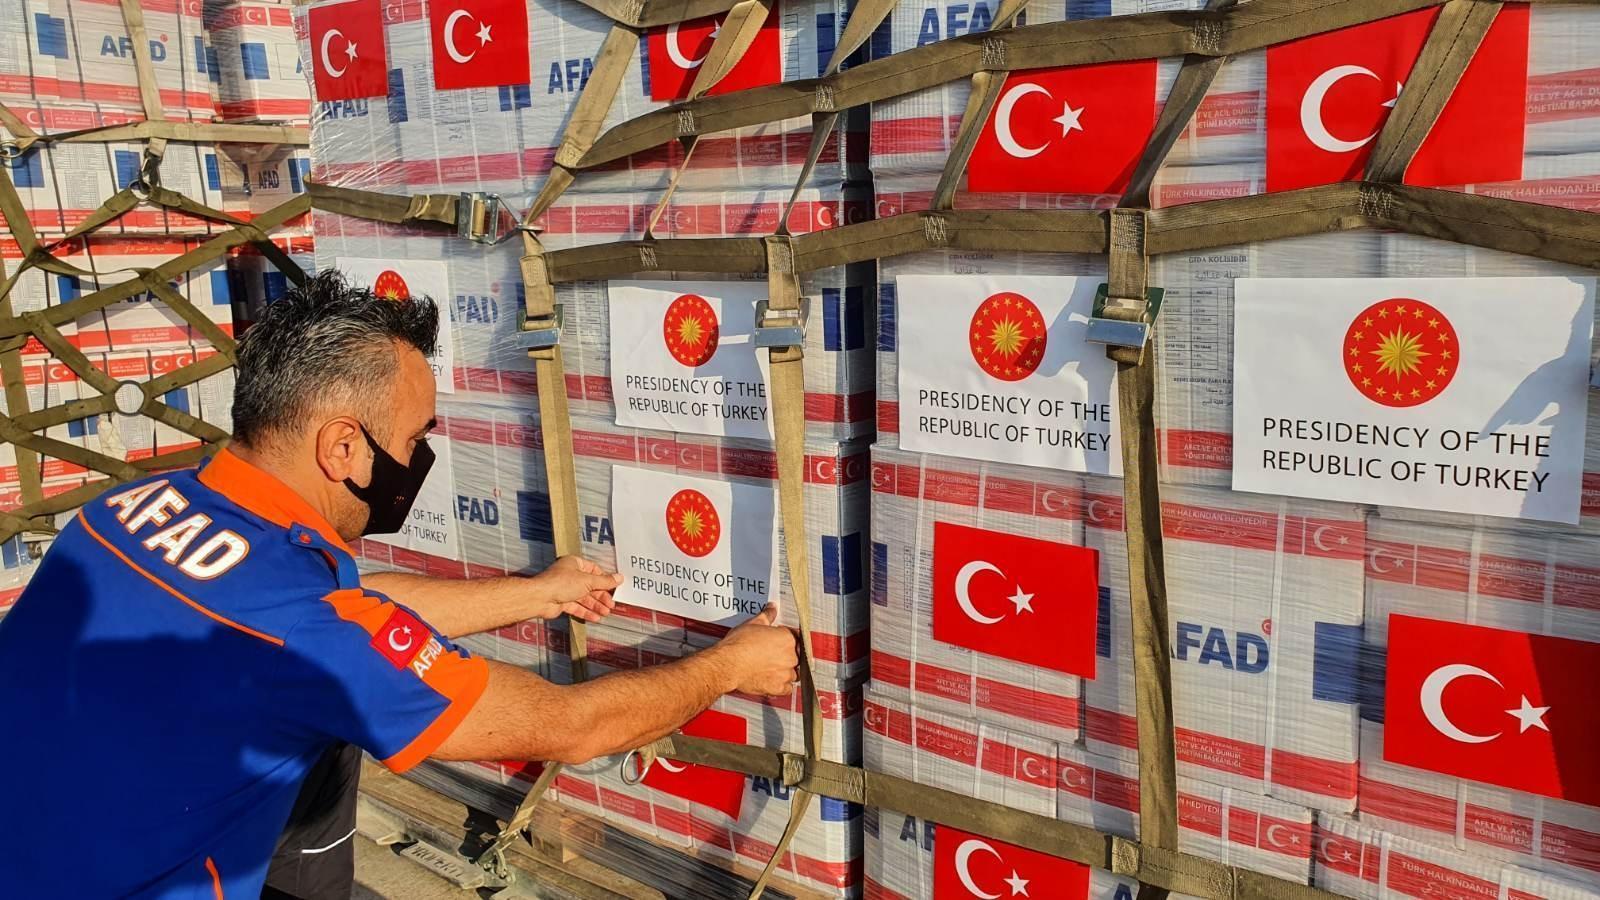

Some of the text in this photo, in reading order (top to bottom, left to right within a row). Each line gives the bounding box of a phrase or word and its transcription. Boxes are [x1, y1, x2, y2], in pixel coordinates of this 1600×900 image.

[100, 35, 167, 62] AFD
[548, 58, 594, 94] AFA
[626, 375, 709, 393] PRESIDENCY
[713, 381, 733, 396] OF
[739, 383, 766, 398] THE
[629, 397, 767, 421] REPUBLIC OF TURKEY
[919, 389, 1111, 422] PRESIDENCY OF THE
[919, 416, 1112, 451] REPUBLIC OF TURKEY
[1263, 417, 1550, 458] PRESIDENCY OF THE
[1263, 450, 1550, 493] REPUBLIC OF TURKEY
[106, 479, 250, 581] AFAD
[402, 524, 447, 544] OF TURKEY
[413, 508, 446, 526] OF THE
[582, 515, 615, 546] FA
[631, 555, 765, 595] PRESIDENCY OF THE
[633, 576, 767, 615] REPUBLIC OF TURKEY
[412, 635, 443, 678] AFAD
[1170, 621, 1270, 674] FAD
[899, 815, 935, 851] AF
